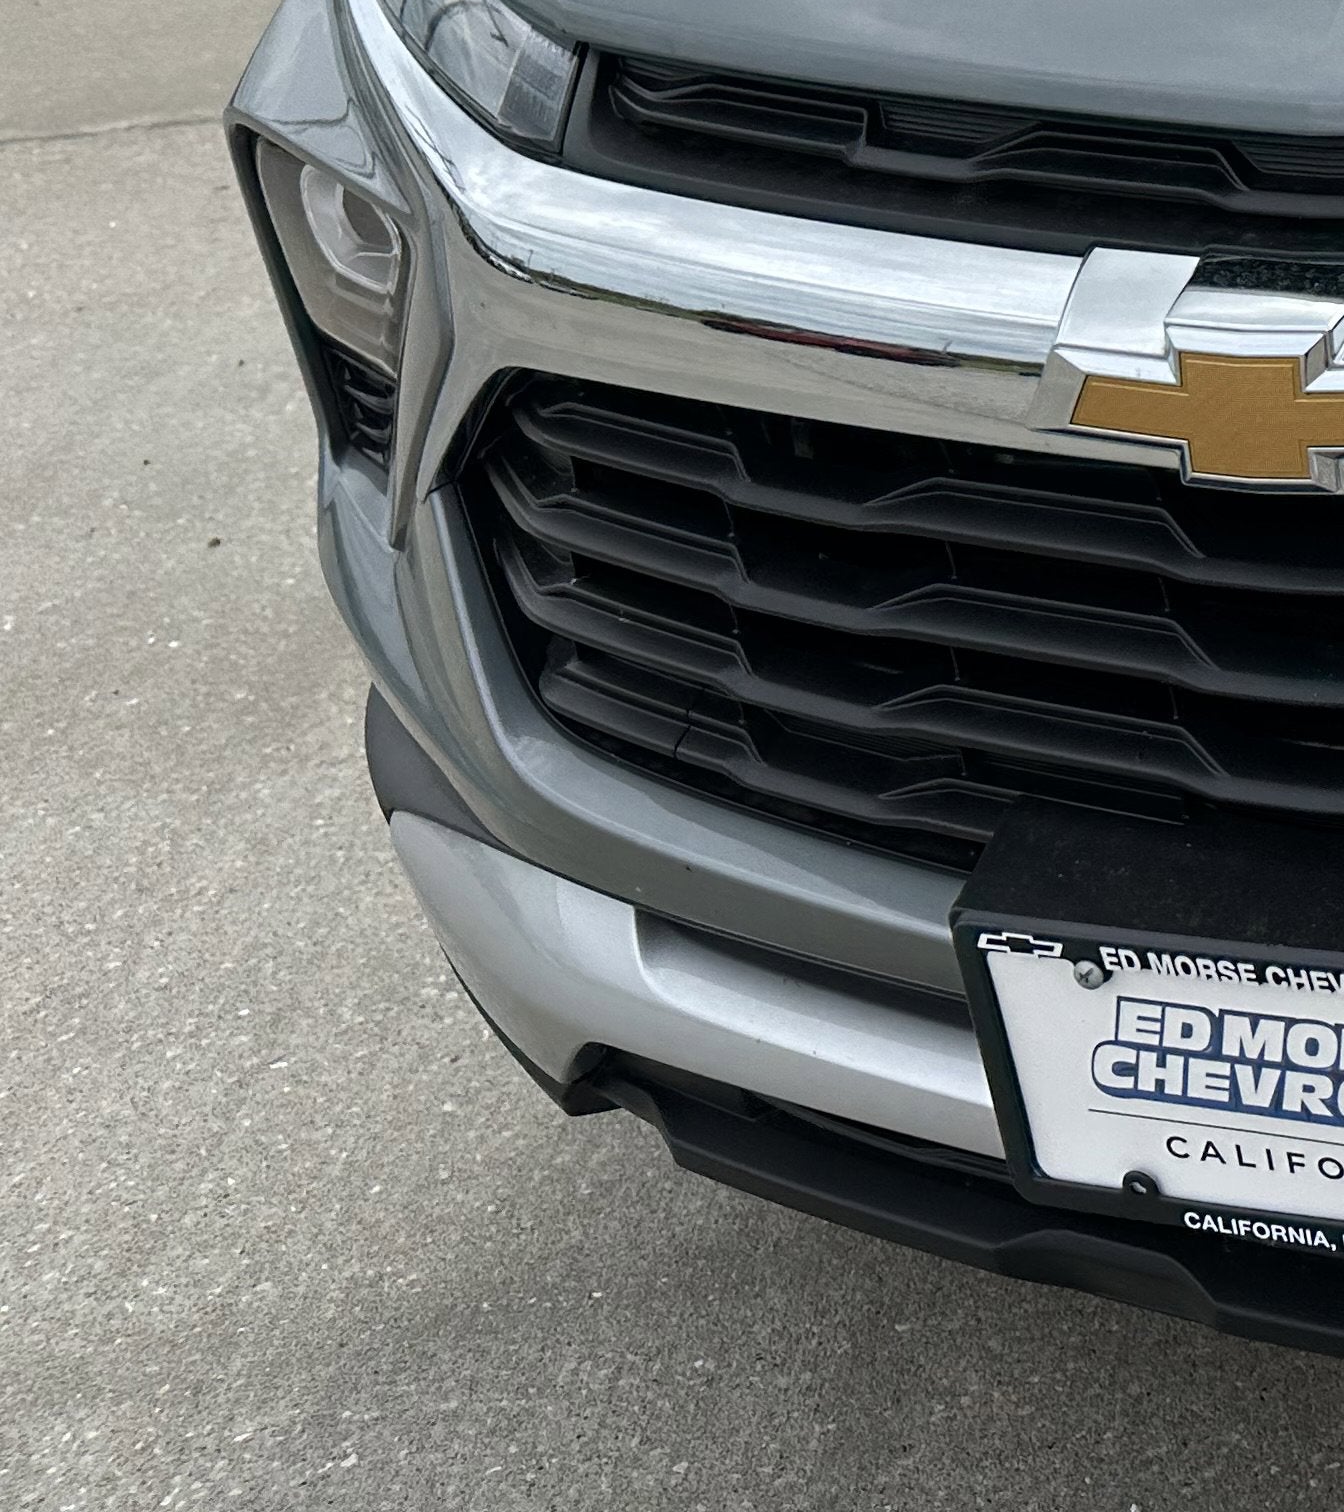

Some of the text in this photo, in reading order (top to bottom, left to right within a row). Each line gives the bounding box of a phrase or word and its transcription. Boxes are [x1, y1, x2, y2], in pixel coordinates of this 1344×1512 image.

[1099, 945, 1142, 973] ED
[1146, 953, 1257, 986] MORSE
[1115, 996, 1216, 1053] ED
[1183, 1211, 1337, 1252] CALIFORNIA,
